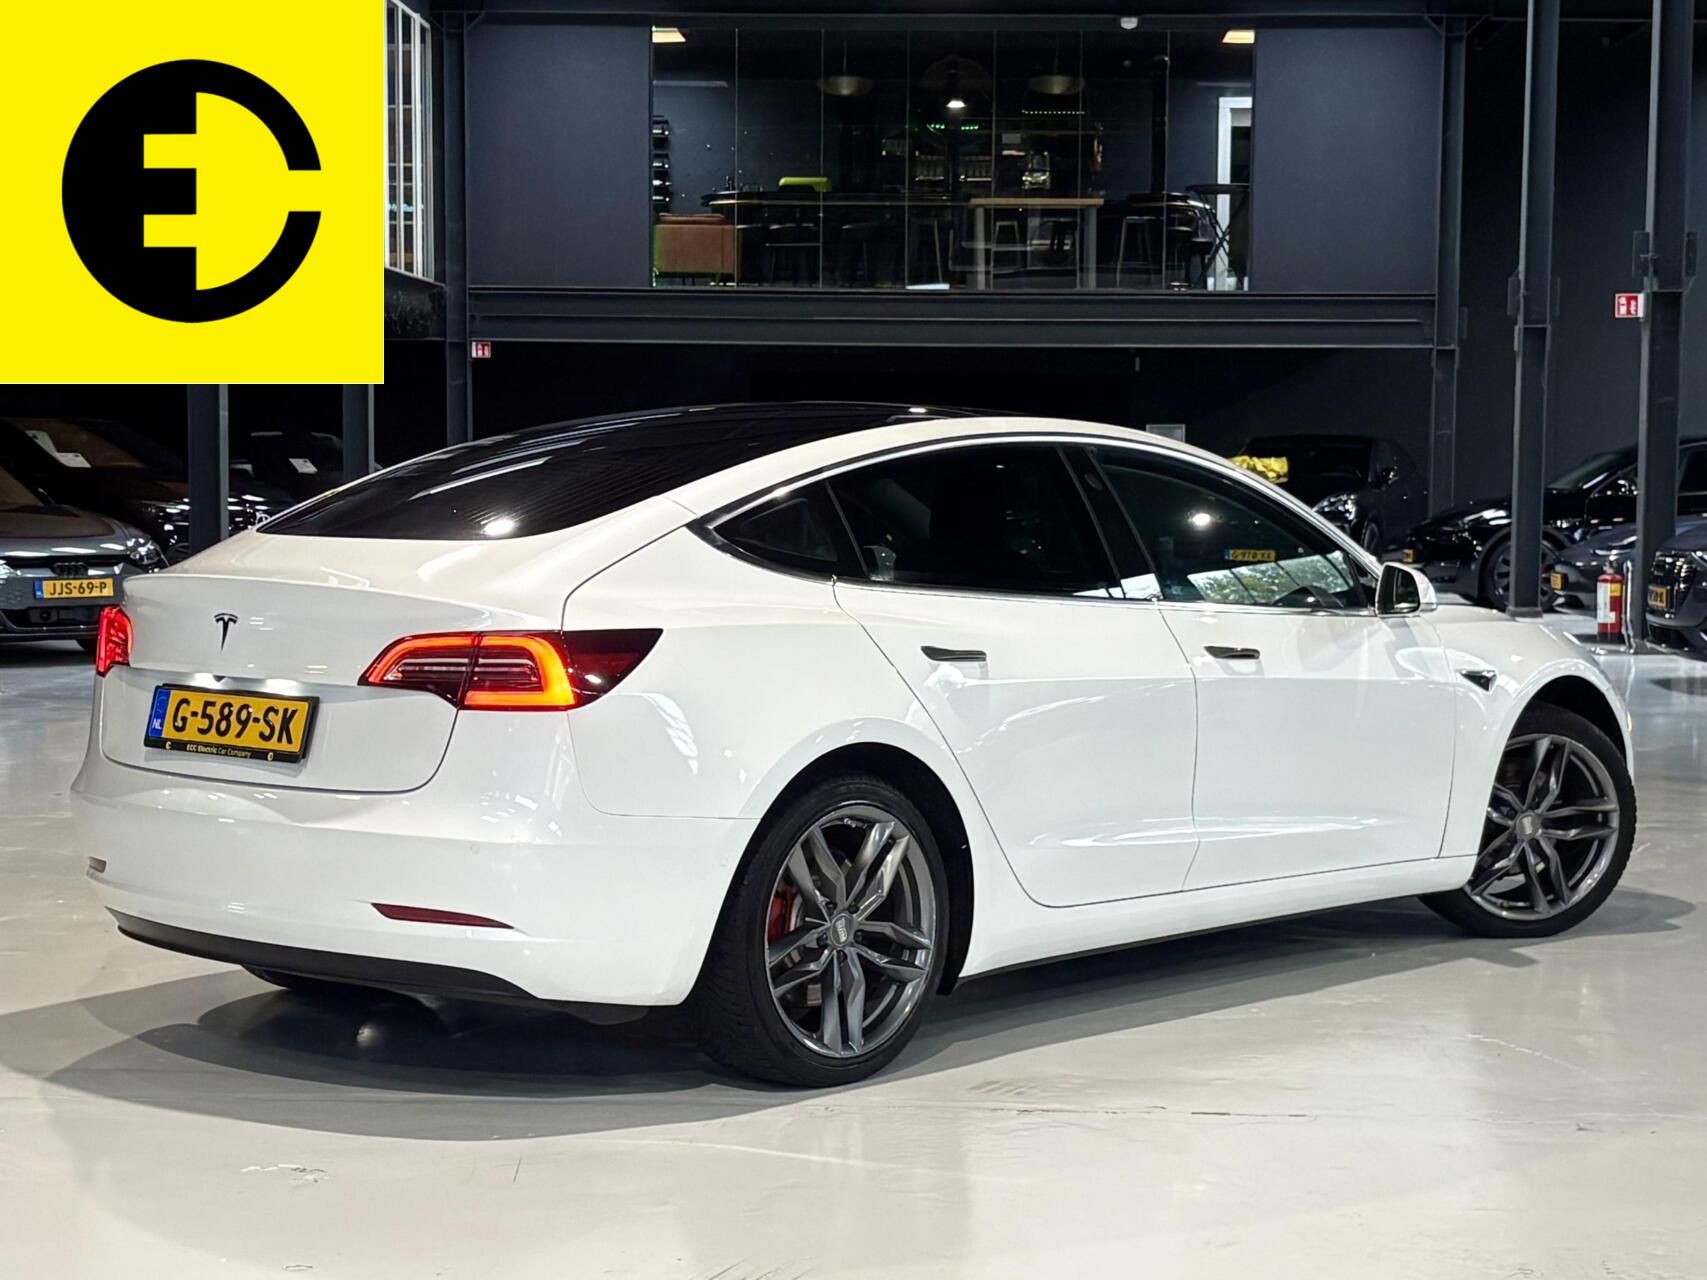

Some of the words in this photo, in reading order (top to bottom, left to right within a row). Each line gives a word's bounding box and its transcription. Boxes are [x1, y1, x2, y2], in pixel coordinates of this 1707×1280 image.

[49, 581, 107, 596] JJS-69-P
[172, 698, 298, 745] G-589-SK
[197, 744, 217, 754] Electric
[218, 746, 227, 755] Car
[227, 748, 252, 759] Company
